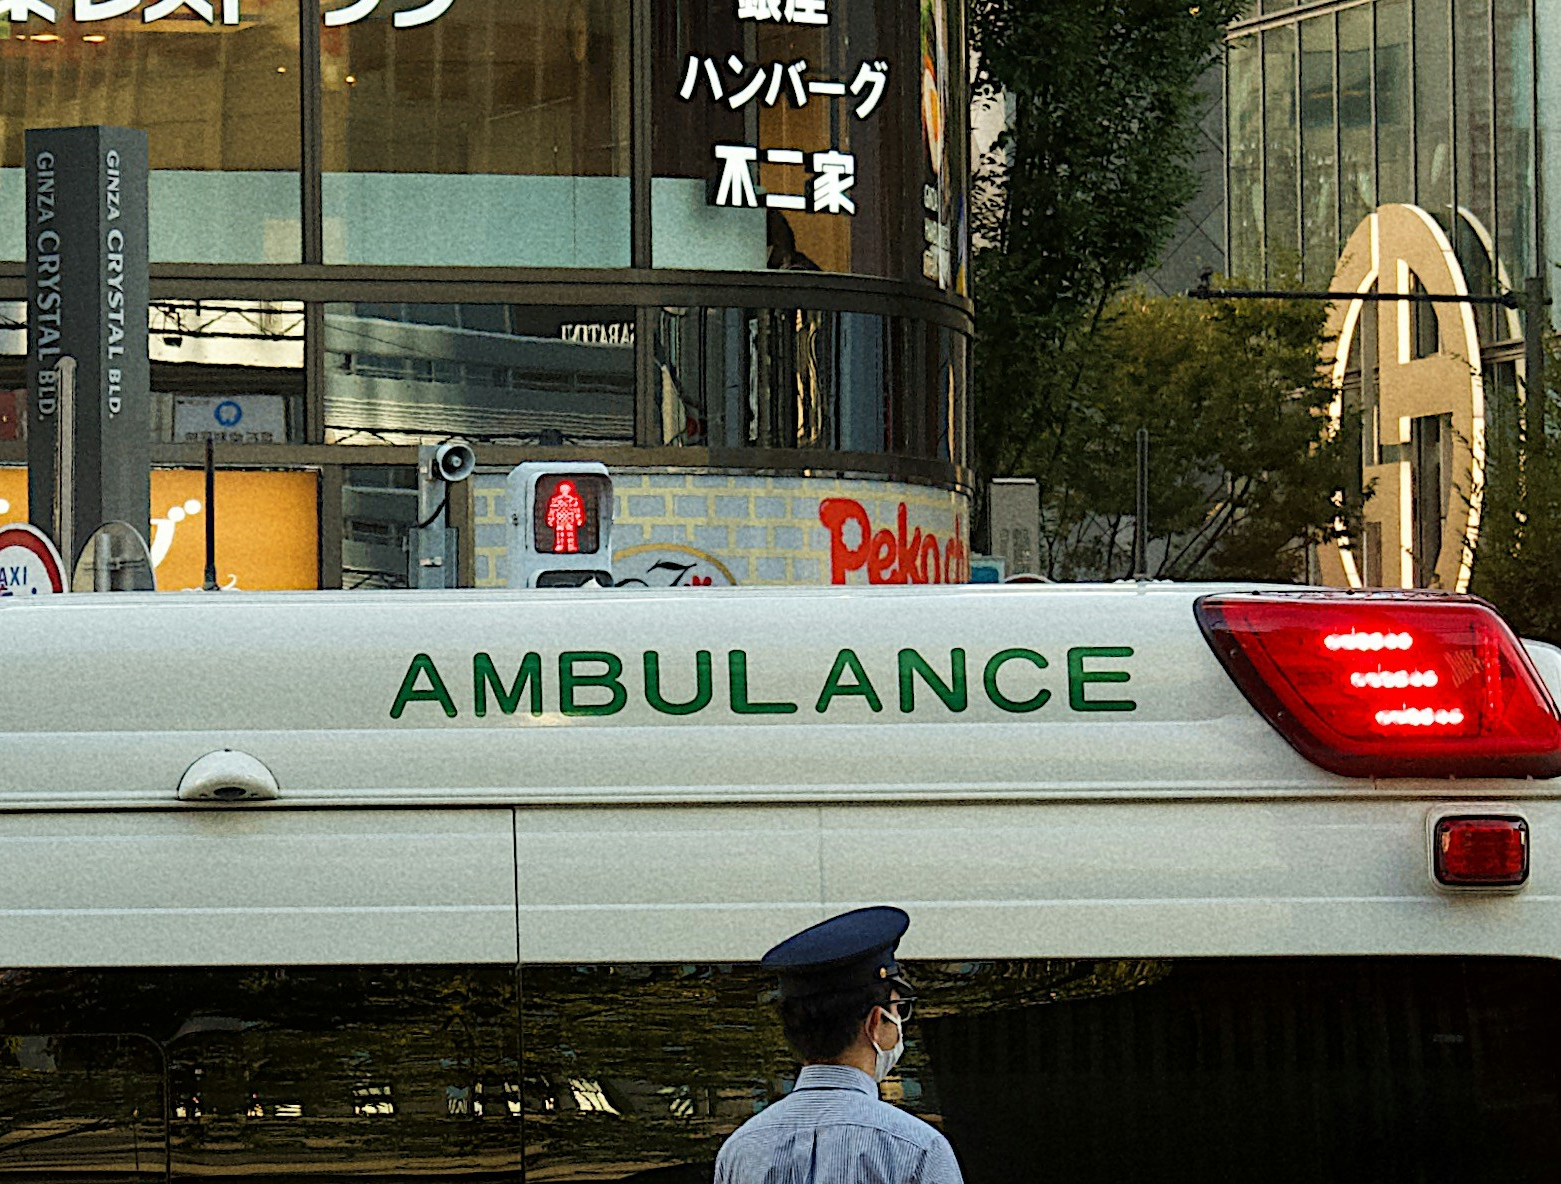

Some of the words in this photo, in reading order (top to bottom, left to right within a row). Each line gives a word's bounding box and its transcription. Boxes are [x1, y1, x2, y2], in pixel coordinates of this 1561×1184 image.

[680, 54, 889, 119] ハンバーグ
[36, 151, 56, 224] GINZA
[106, 149, 121, 221] GINZA
[714, 144, 856, 215] 不二家
[37, 230, 62, 362] CRYSTAL
[107, 228, 125, 359] CRYSTAL
[108, 368, 122, 420] BLD.
[389, 645, 1138, 719] AMBULANCE
